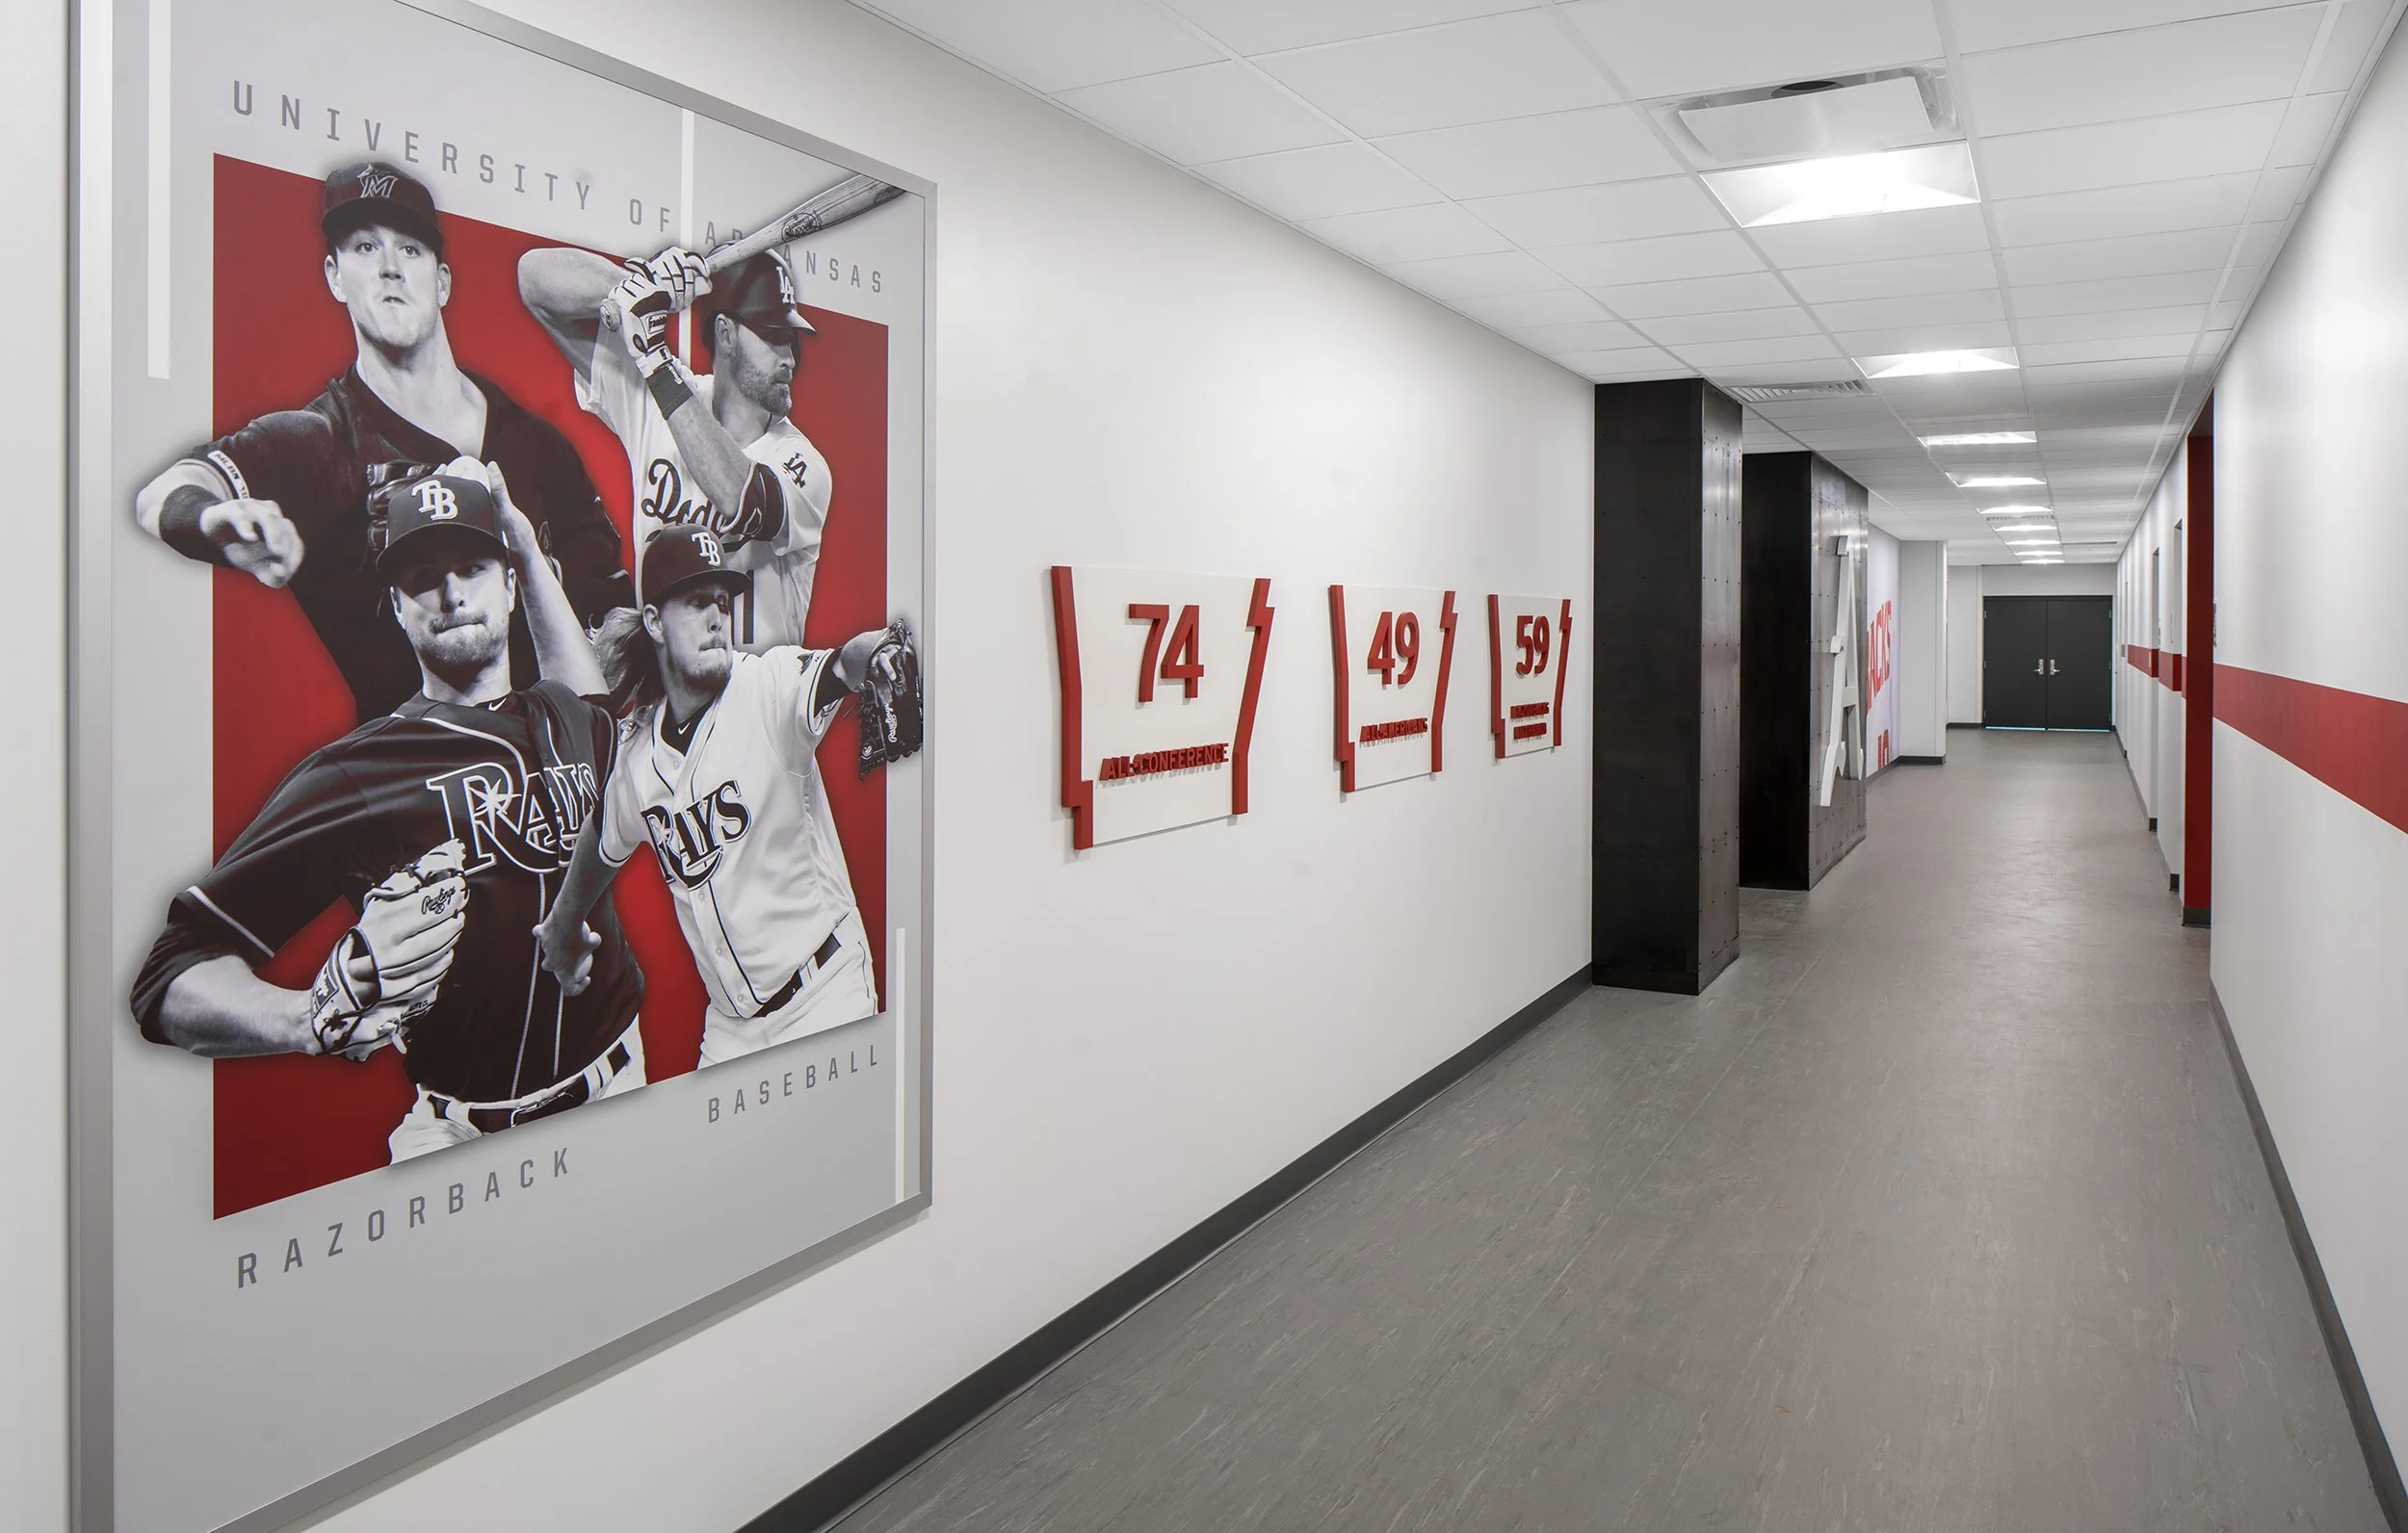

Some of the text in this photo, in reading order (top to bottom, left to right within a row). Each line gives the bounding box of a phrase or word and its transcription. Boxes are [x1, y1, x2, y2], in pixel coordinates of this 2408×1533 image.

[233, 80, 881, 293] UNIVERSITY OF AANSAS
[411, 480, 458, 521] TB
[691, 532, 721, 566] TB
[1128, 603, 1204, 703] 74
[1367, 611, 1420, 685] 49
[1515, 615, 1550, 675] 59
[1099, 742, 1229, 782] ALL-CONFERENCE
[641, 779, 752, 892] RAYS
[237, 1044, 877, 1289] RAZORBACK BASEBALL
